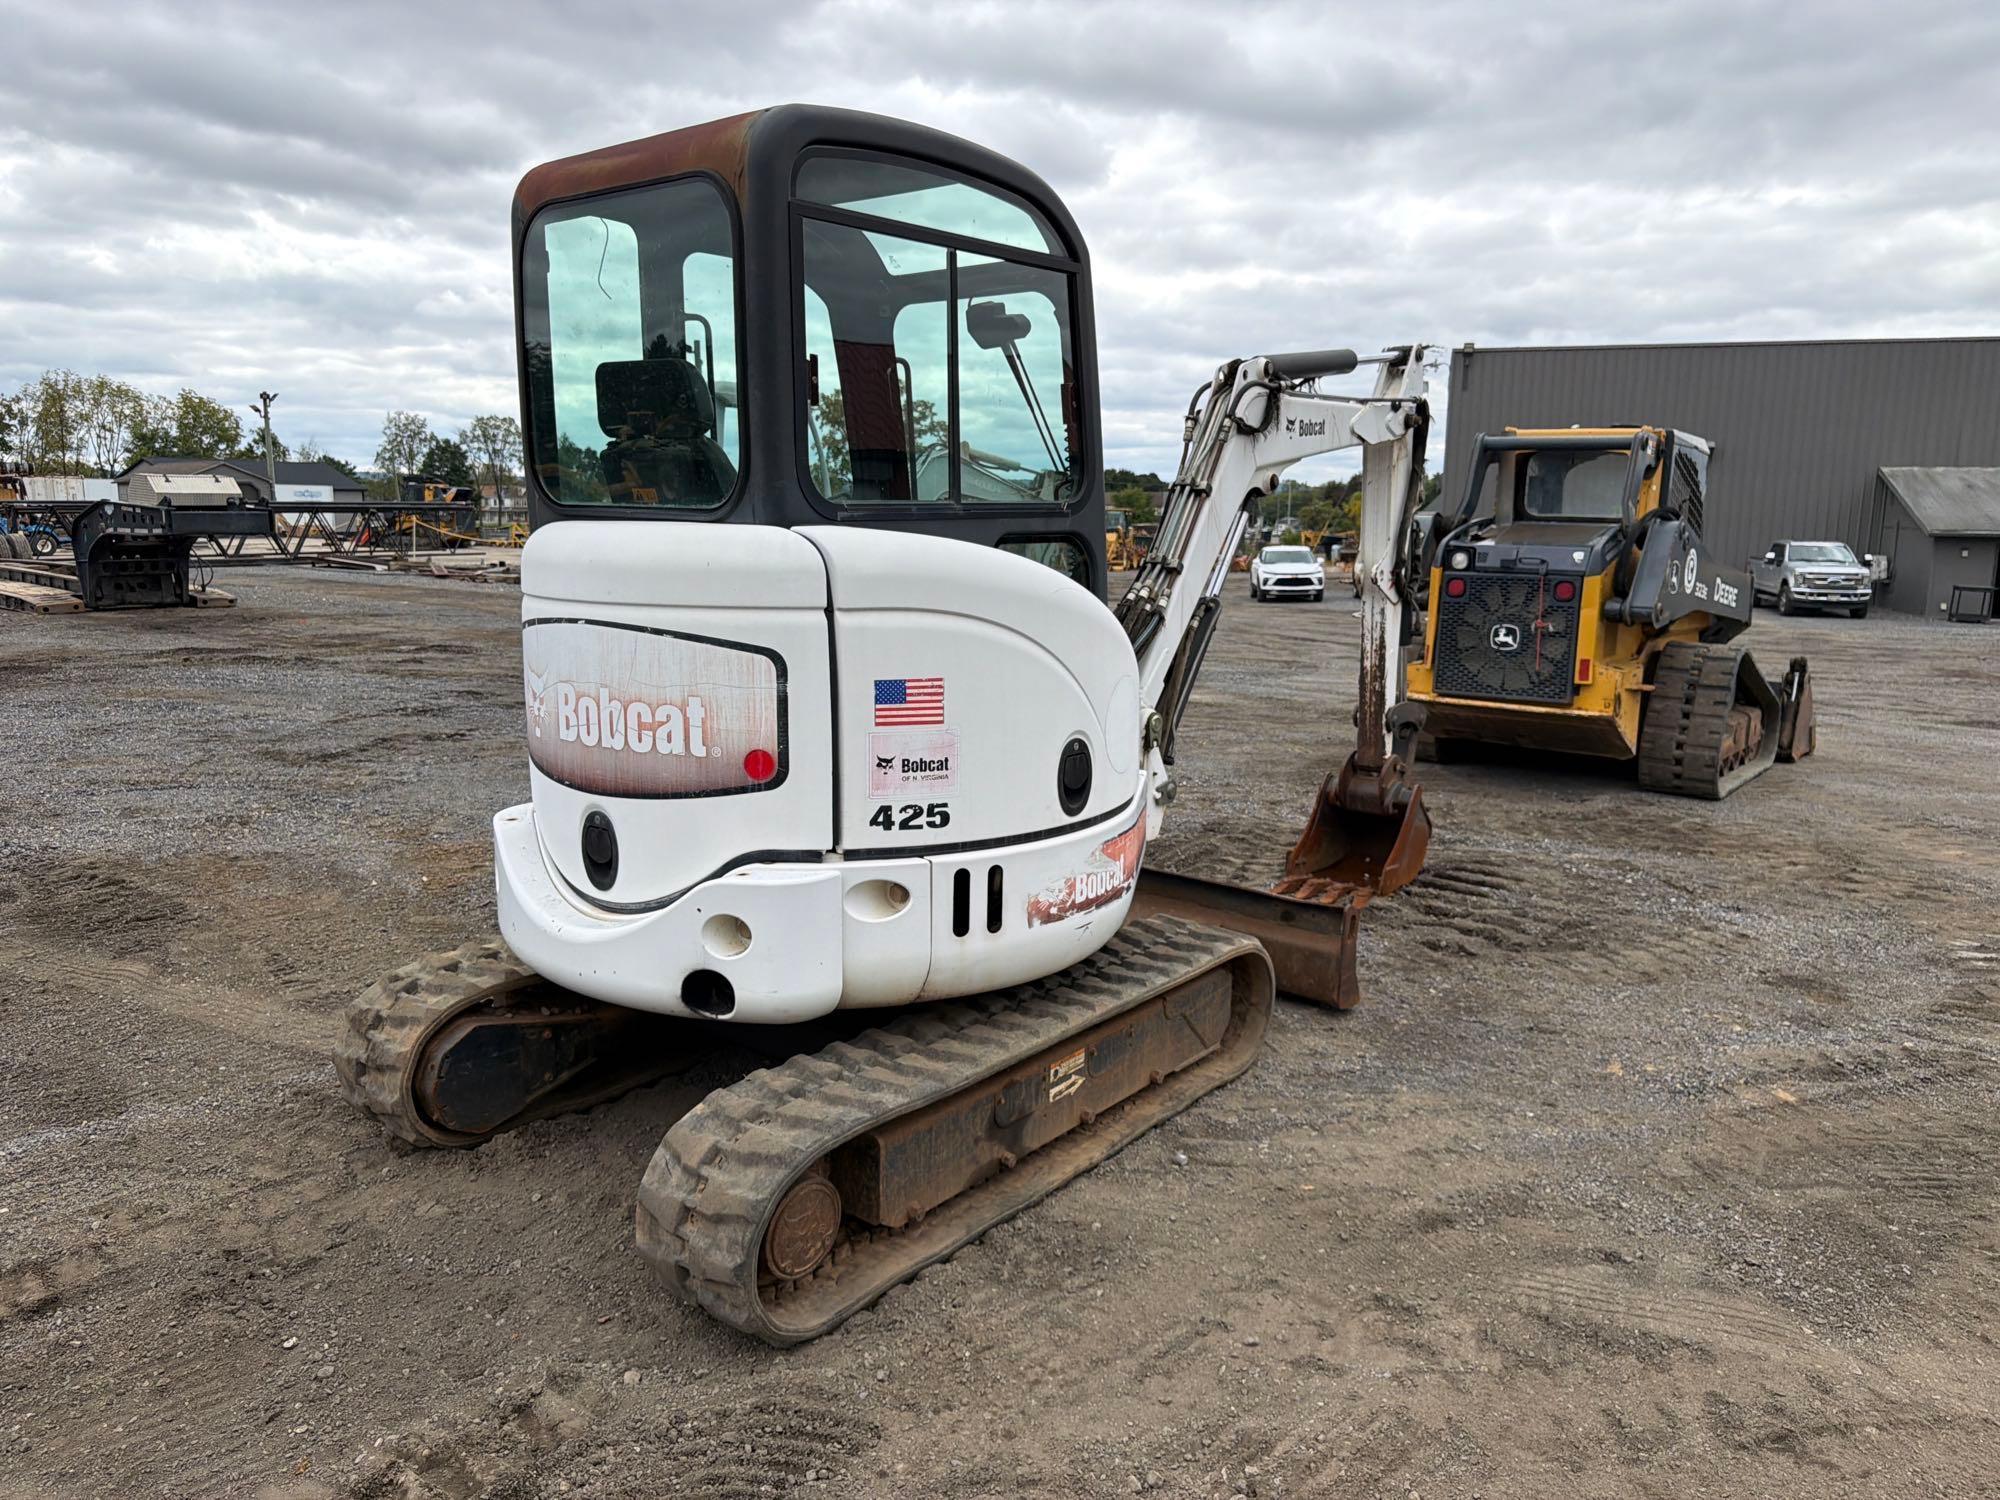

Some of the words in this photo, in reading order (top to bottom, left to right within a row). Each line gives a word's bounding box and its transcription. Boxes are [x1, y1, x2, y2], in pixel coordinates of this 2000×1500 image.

[1299, 418, 1325, 437] Bobcat
[1713, 576, 1738, 608] DEERE
[557, 682, 707, 757] Bobcat
[901, 756, 949, 773] Bobcat
[869, 802, 951, 831] 425
